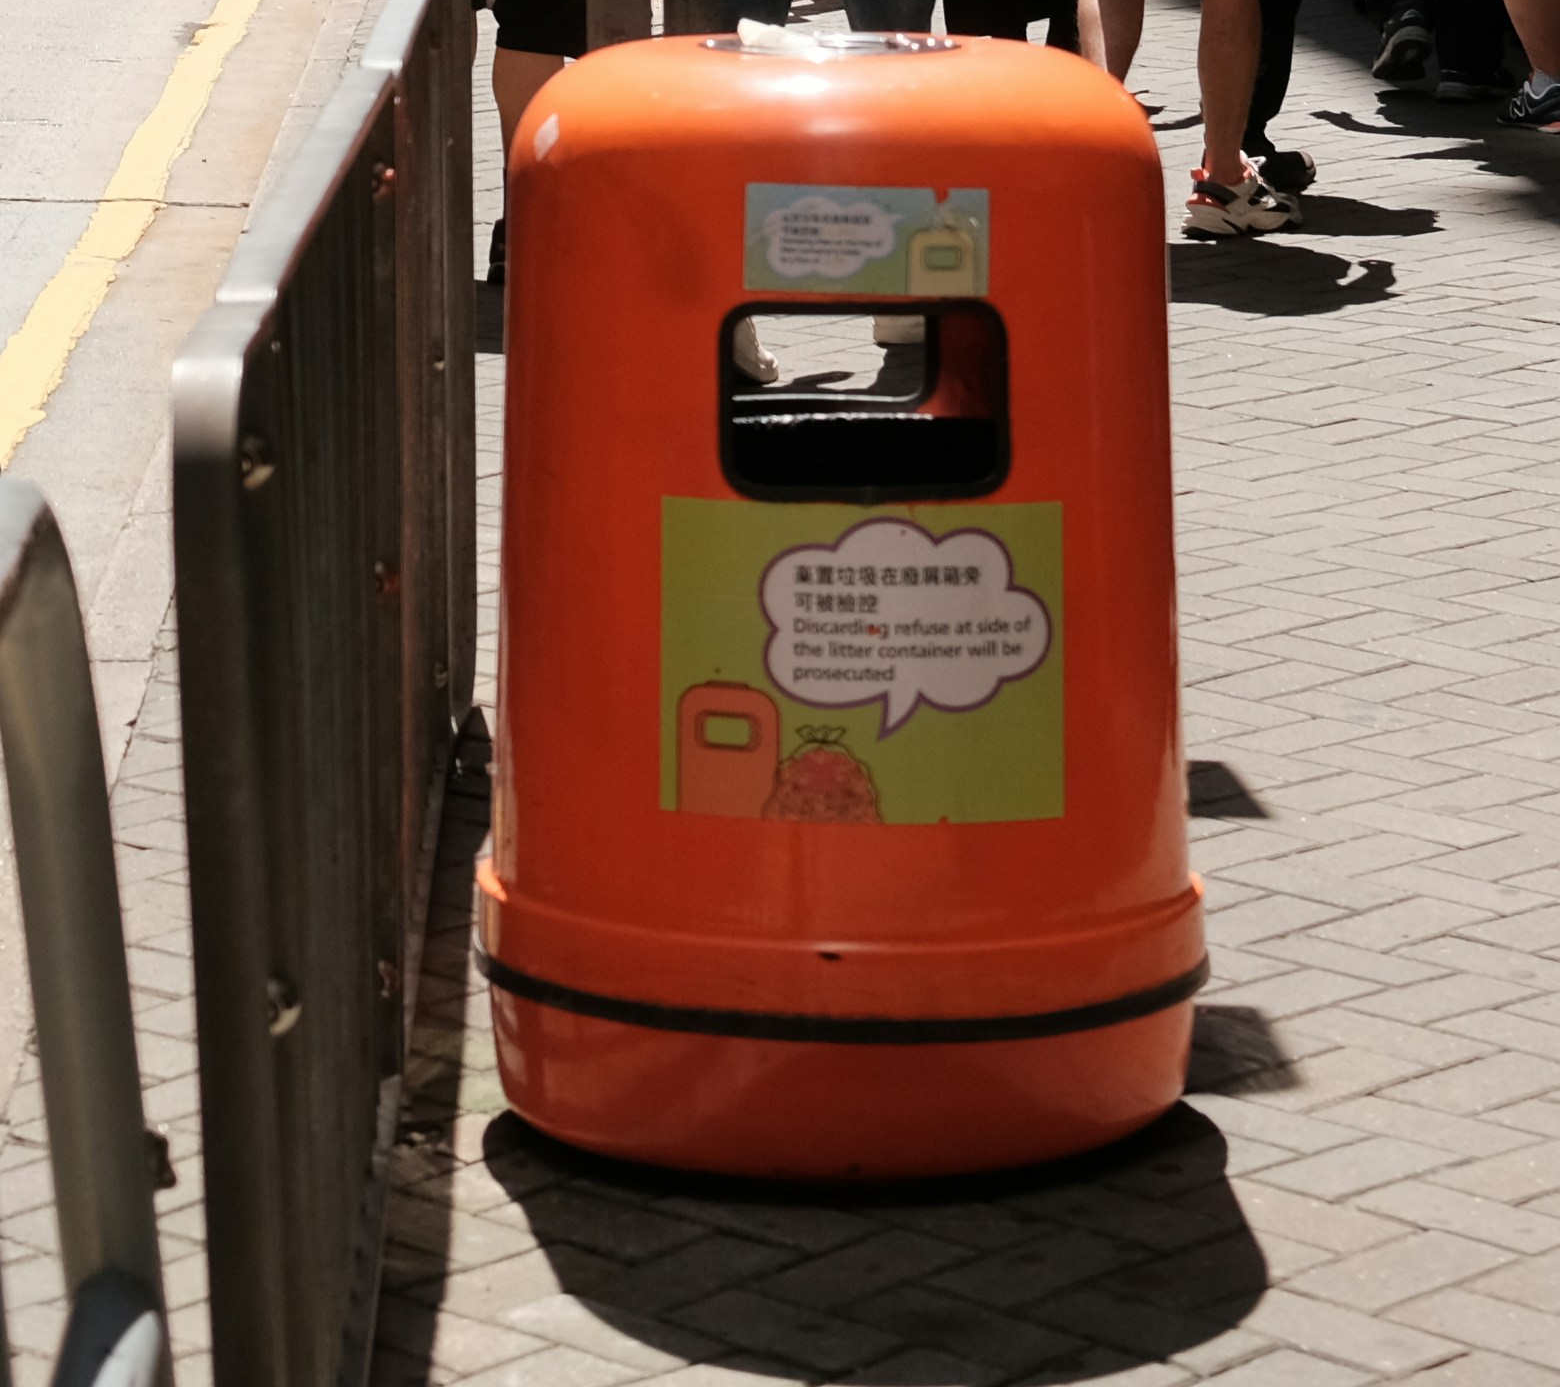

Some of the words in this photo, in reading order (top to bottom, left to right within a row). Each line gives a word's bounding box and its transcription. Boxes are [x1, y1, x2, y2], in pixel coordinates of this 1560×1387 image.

[893, 618, 951, 637] refuse
[954, 620, 972, 636] at
[976, 618, 1009, 635] side
[1013, 615, 1031, 633] of
[792, 641, 823, 658] the
[828, 640, 873, 658] litter
[876, 641, 963, 659] container
[967, 639, 996, 657] will
[1001, 639, 1022, 657] be
[792, 665, 896, 683] prosecuted
